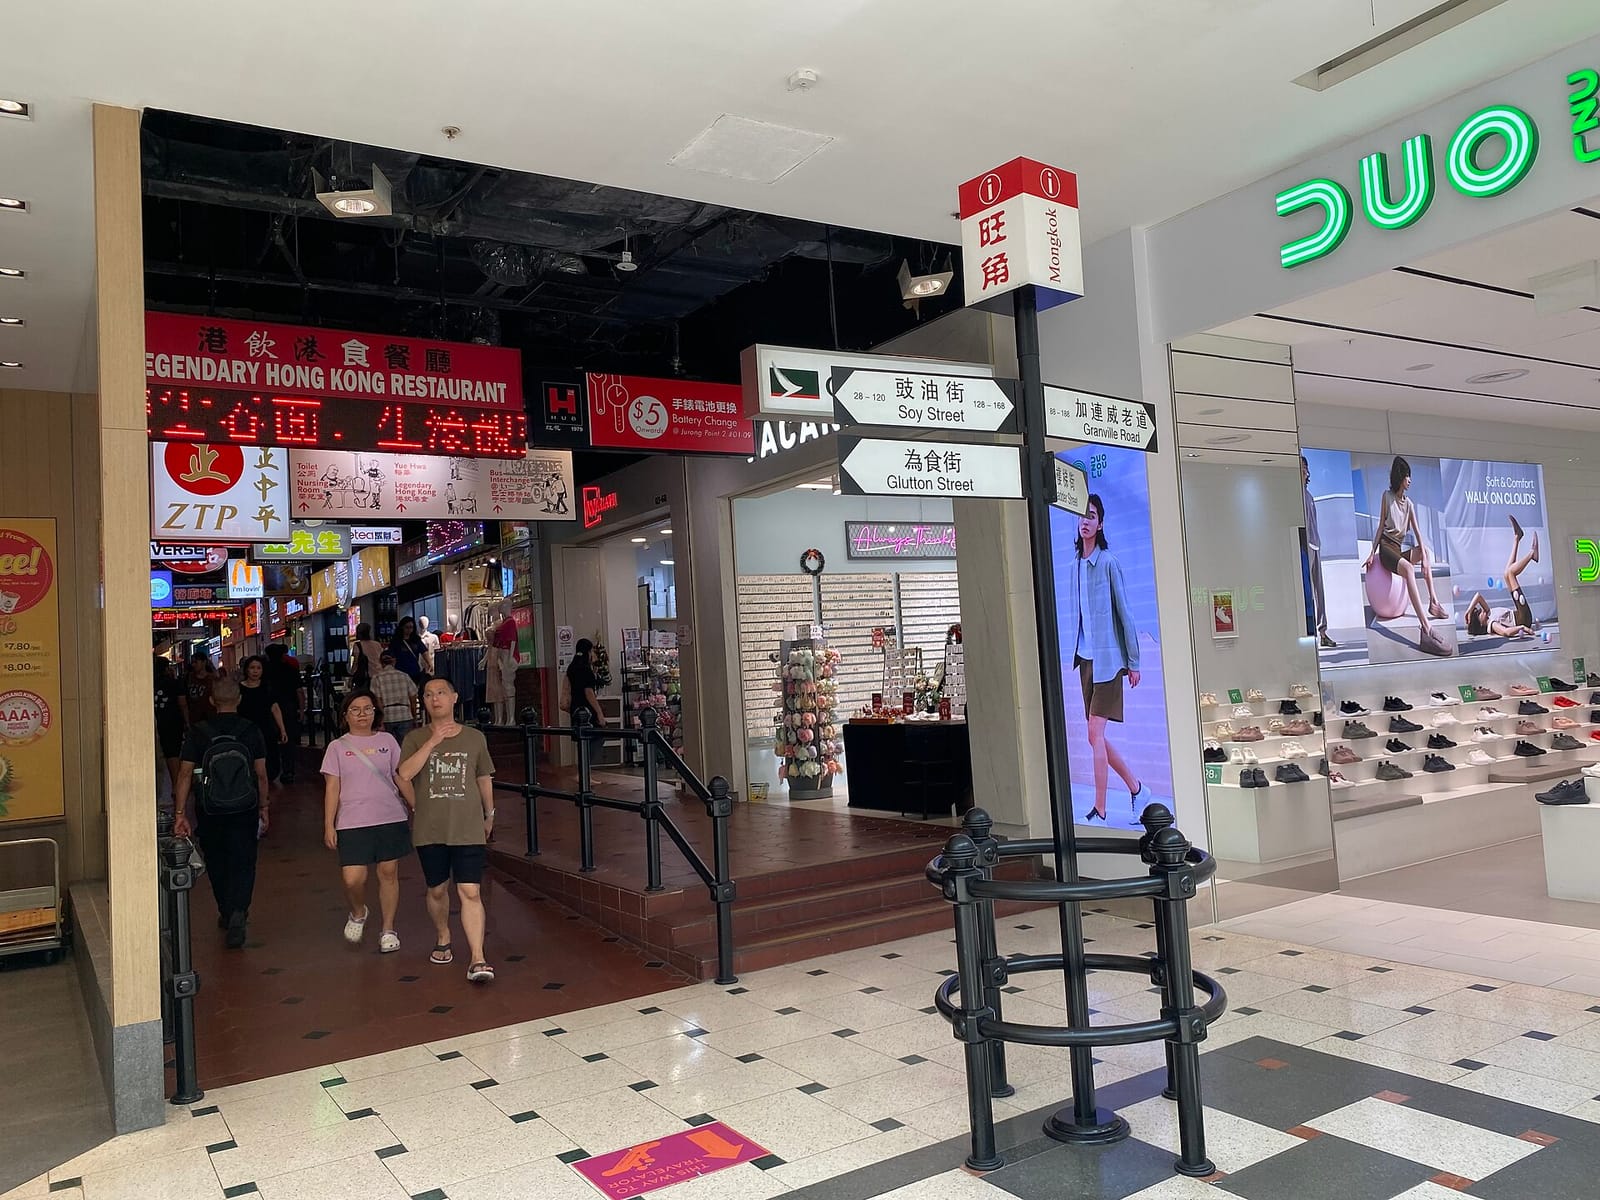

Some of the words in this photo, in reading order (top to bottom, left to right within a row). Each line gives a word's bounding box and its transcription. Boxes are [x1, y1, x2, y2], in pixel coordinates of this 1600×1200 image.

[1275, 104, 1540, 268] DUO
[978, 209, 1010, 291] 旺角
[1045, 208, 1062, 283] Mongkok
[266, 363, 325, 390] HONG
[330, 368, 385, 394] KONG
[390, 373, 507, 404] RESTAURANT
[895, 377, 964, 404] 豉油街
[672, 414, 702, 427] Battery
[704, 416, 738, 429] Change
[898, 404, 923, 423] Soy
[927, 406, 965, 423] Street
[1075, 398, 1148, 430] 加連威老道
[635, 426, 664, 434] Onwards
[680, 429, 702, 438] Jurong
[1083, 422, 1118, 440] Granville
[1120, 428, 1140, 443] Road
[904, 448, 962, 474] 為食街
[297, 480, 328, 489] Nursing
[394, 482, 432, 490] Legendary
[886, 474, 934, 490] Glutton
[936, 476, 974, 492] Street
[1486, 476, 1500, 488] Soft
[1500, 477, 1506, 488] &
[1506, 477, 1534, 488] Comfort
[395, 488, 416, 497] Hong
[418, 489, 436, 498] Kong
[1465, 491, 1489, 504] WALK
[1490, 492, 1502, 504] ON
[1504, 492, 1536, 505] CLOUDS
[161, 504, 238, 530] ZTP
[853, 526, 914, 553] Always
[607, 1157, 703, 1188] TRAVELATOR
[676, 1162, 710, 1176] THIS
[616, 1184, 638, 1194] TO
[640, 1174, 674, 1187] WAY
